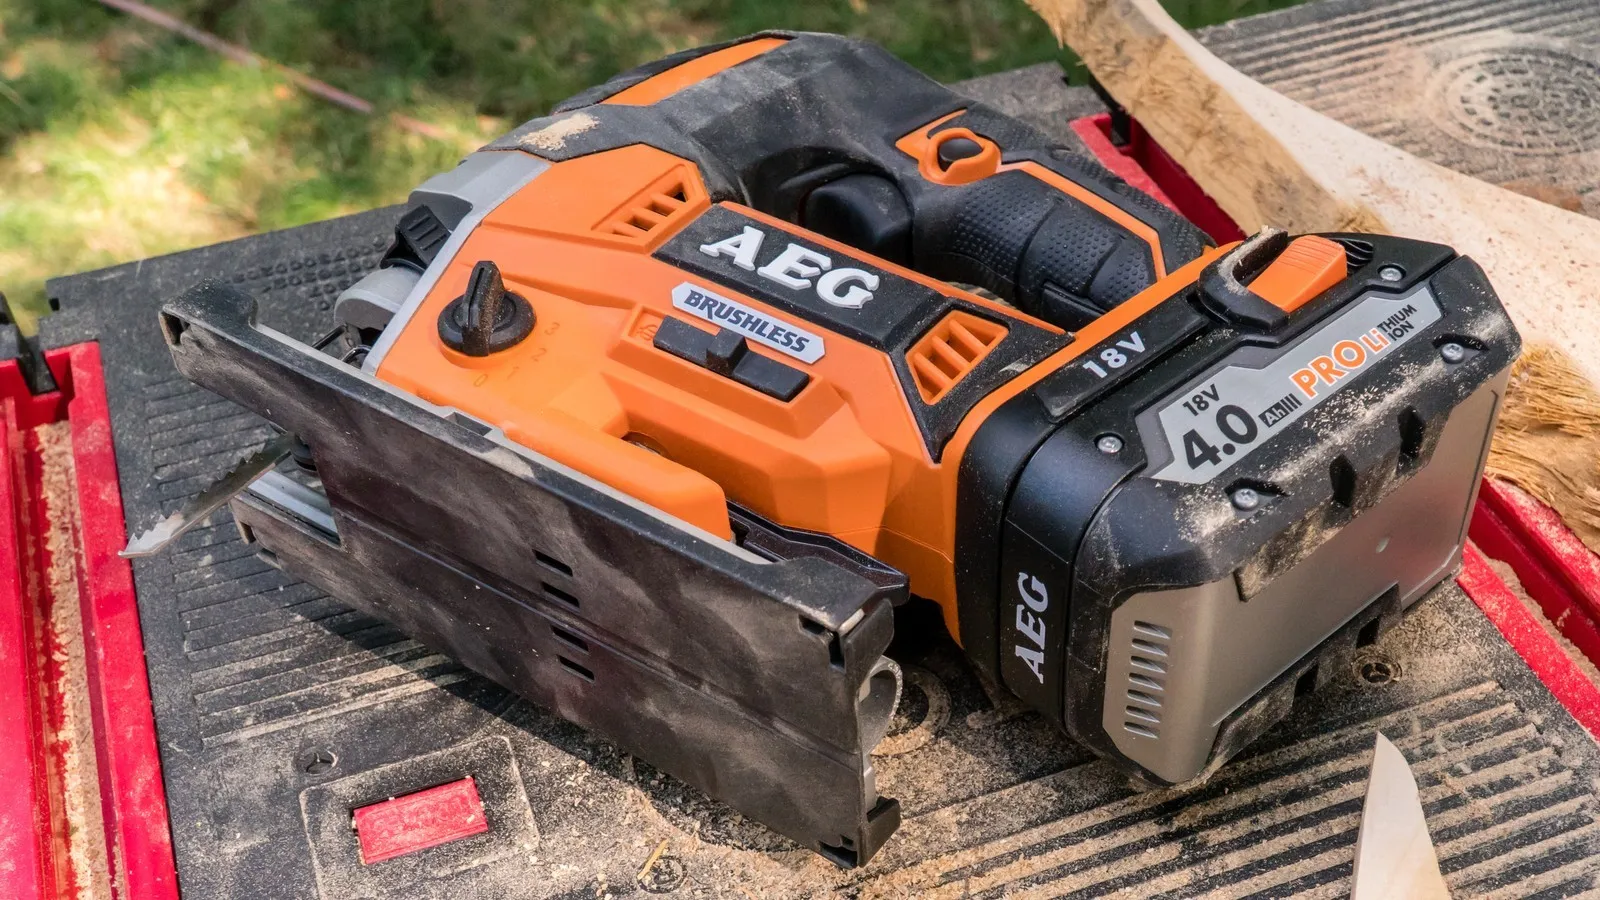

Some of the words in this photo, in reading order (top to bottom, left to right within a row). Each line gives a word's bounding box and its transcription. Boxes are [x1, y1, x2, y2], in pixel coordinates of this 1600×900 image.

[700, 225, 880, 309] AEG
[684, 289, 810, 353] BRUSHLESS
[1388, 320, 1415, 342] ION
[1082, 330, 1146, 379] 18V
[1182, 383, 1221, 417] 18V
[1182, 404, 1258, 470] 4.0
[1014, 571, 1049, 685] AEG
